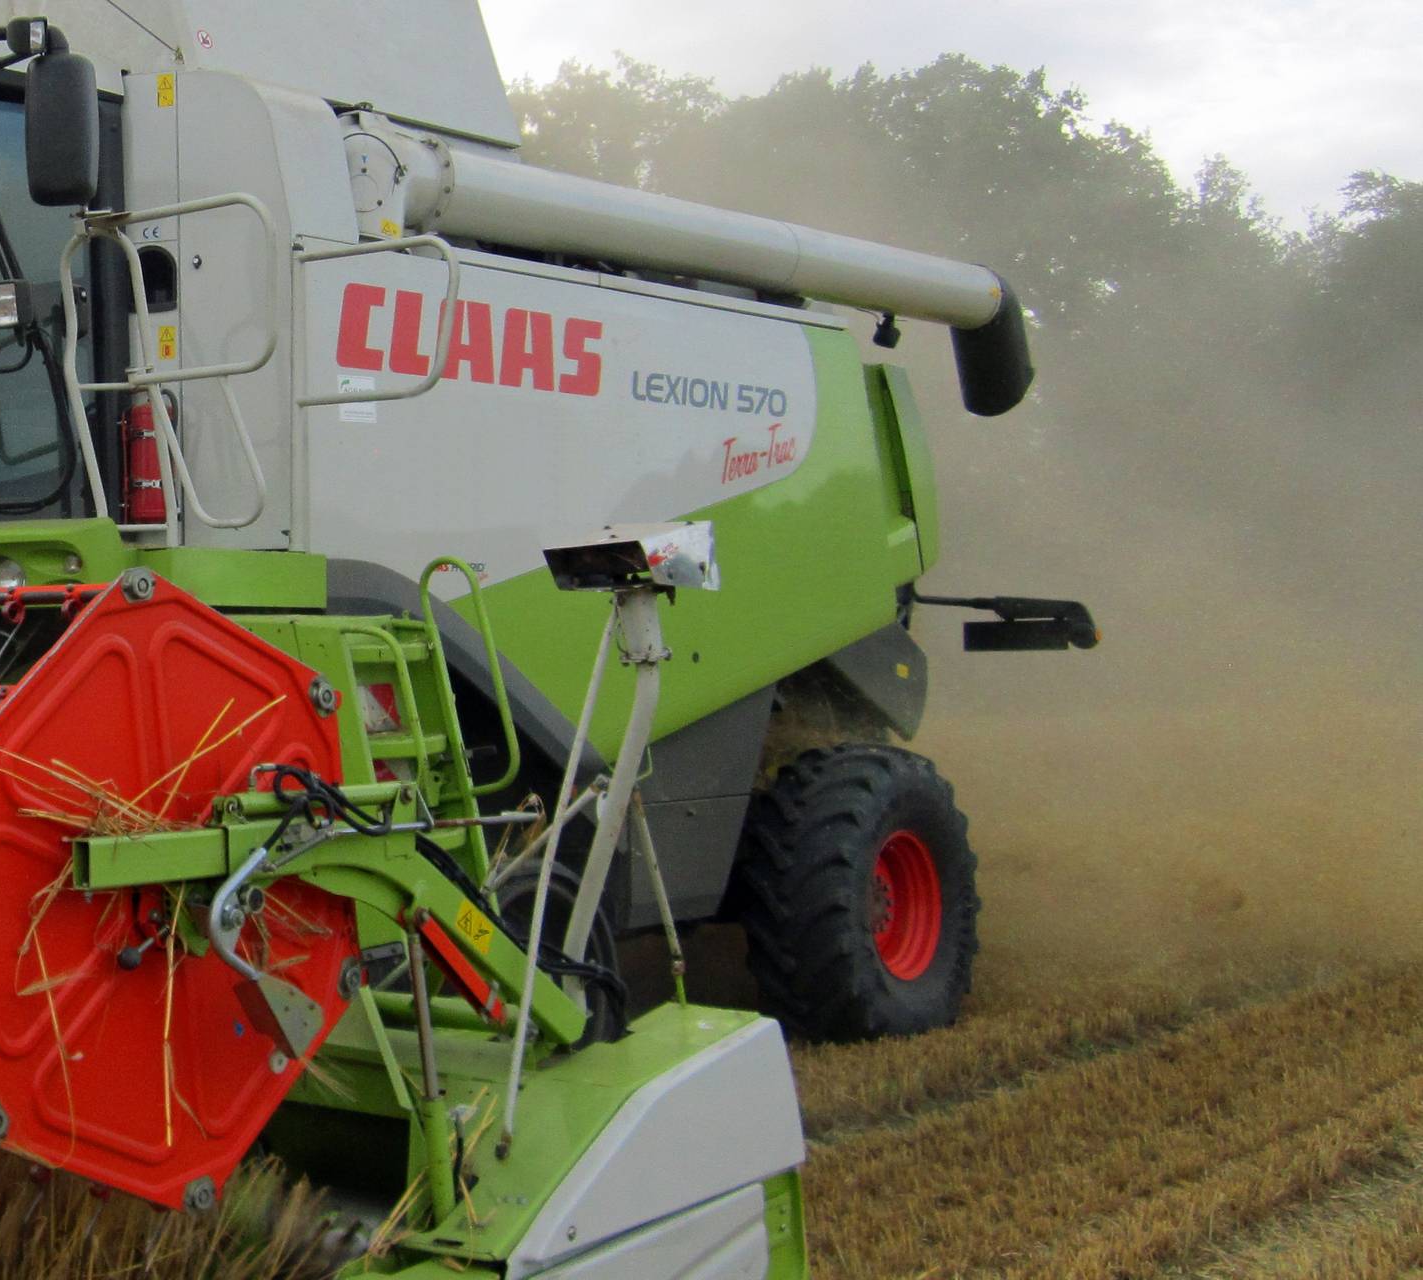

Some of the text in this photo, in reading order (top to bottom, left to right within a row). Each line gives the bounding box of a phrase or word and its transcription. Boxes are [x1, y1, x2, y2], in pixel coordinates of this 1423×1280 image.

[336, 282, 603, 397] CLAAS
[632, 370, 787, 417] LEXION 570
[721, 422, 795, 485] Terra-Trac
